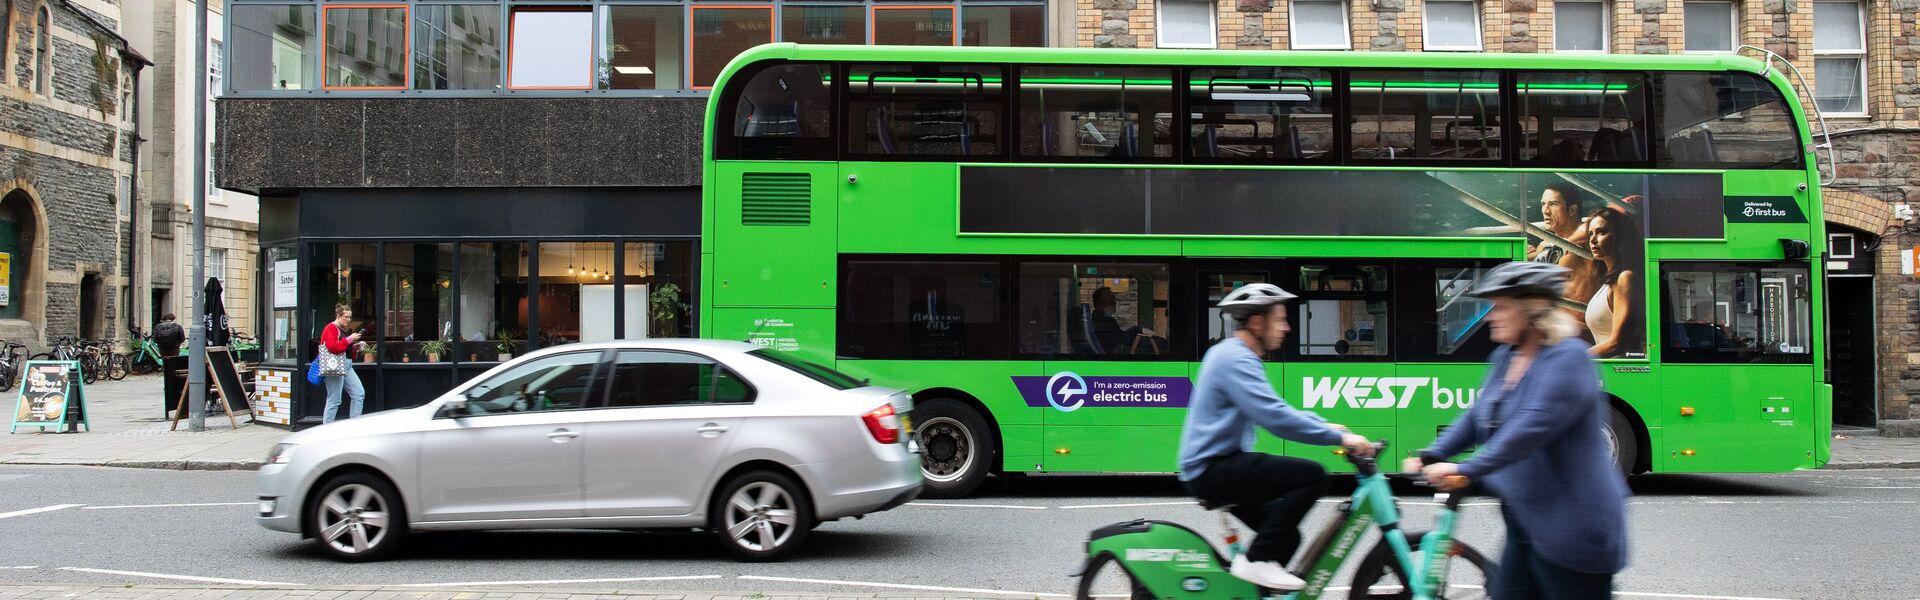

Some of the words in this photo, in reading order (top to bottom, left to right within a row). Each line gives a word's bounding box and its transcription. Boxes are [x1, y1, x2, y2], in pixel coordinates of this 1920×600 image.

[1755, 208, 1771, 216] first
[1771, 208, 1786, 216] bus
[1093, 381, 1106, 389] I'm
[1093, 390, 1142, 402] electric
[1144, 390, 1168, 402] bus
[1302, 376, 1431, 408] WEST
